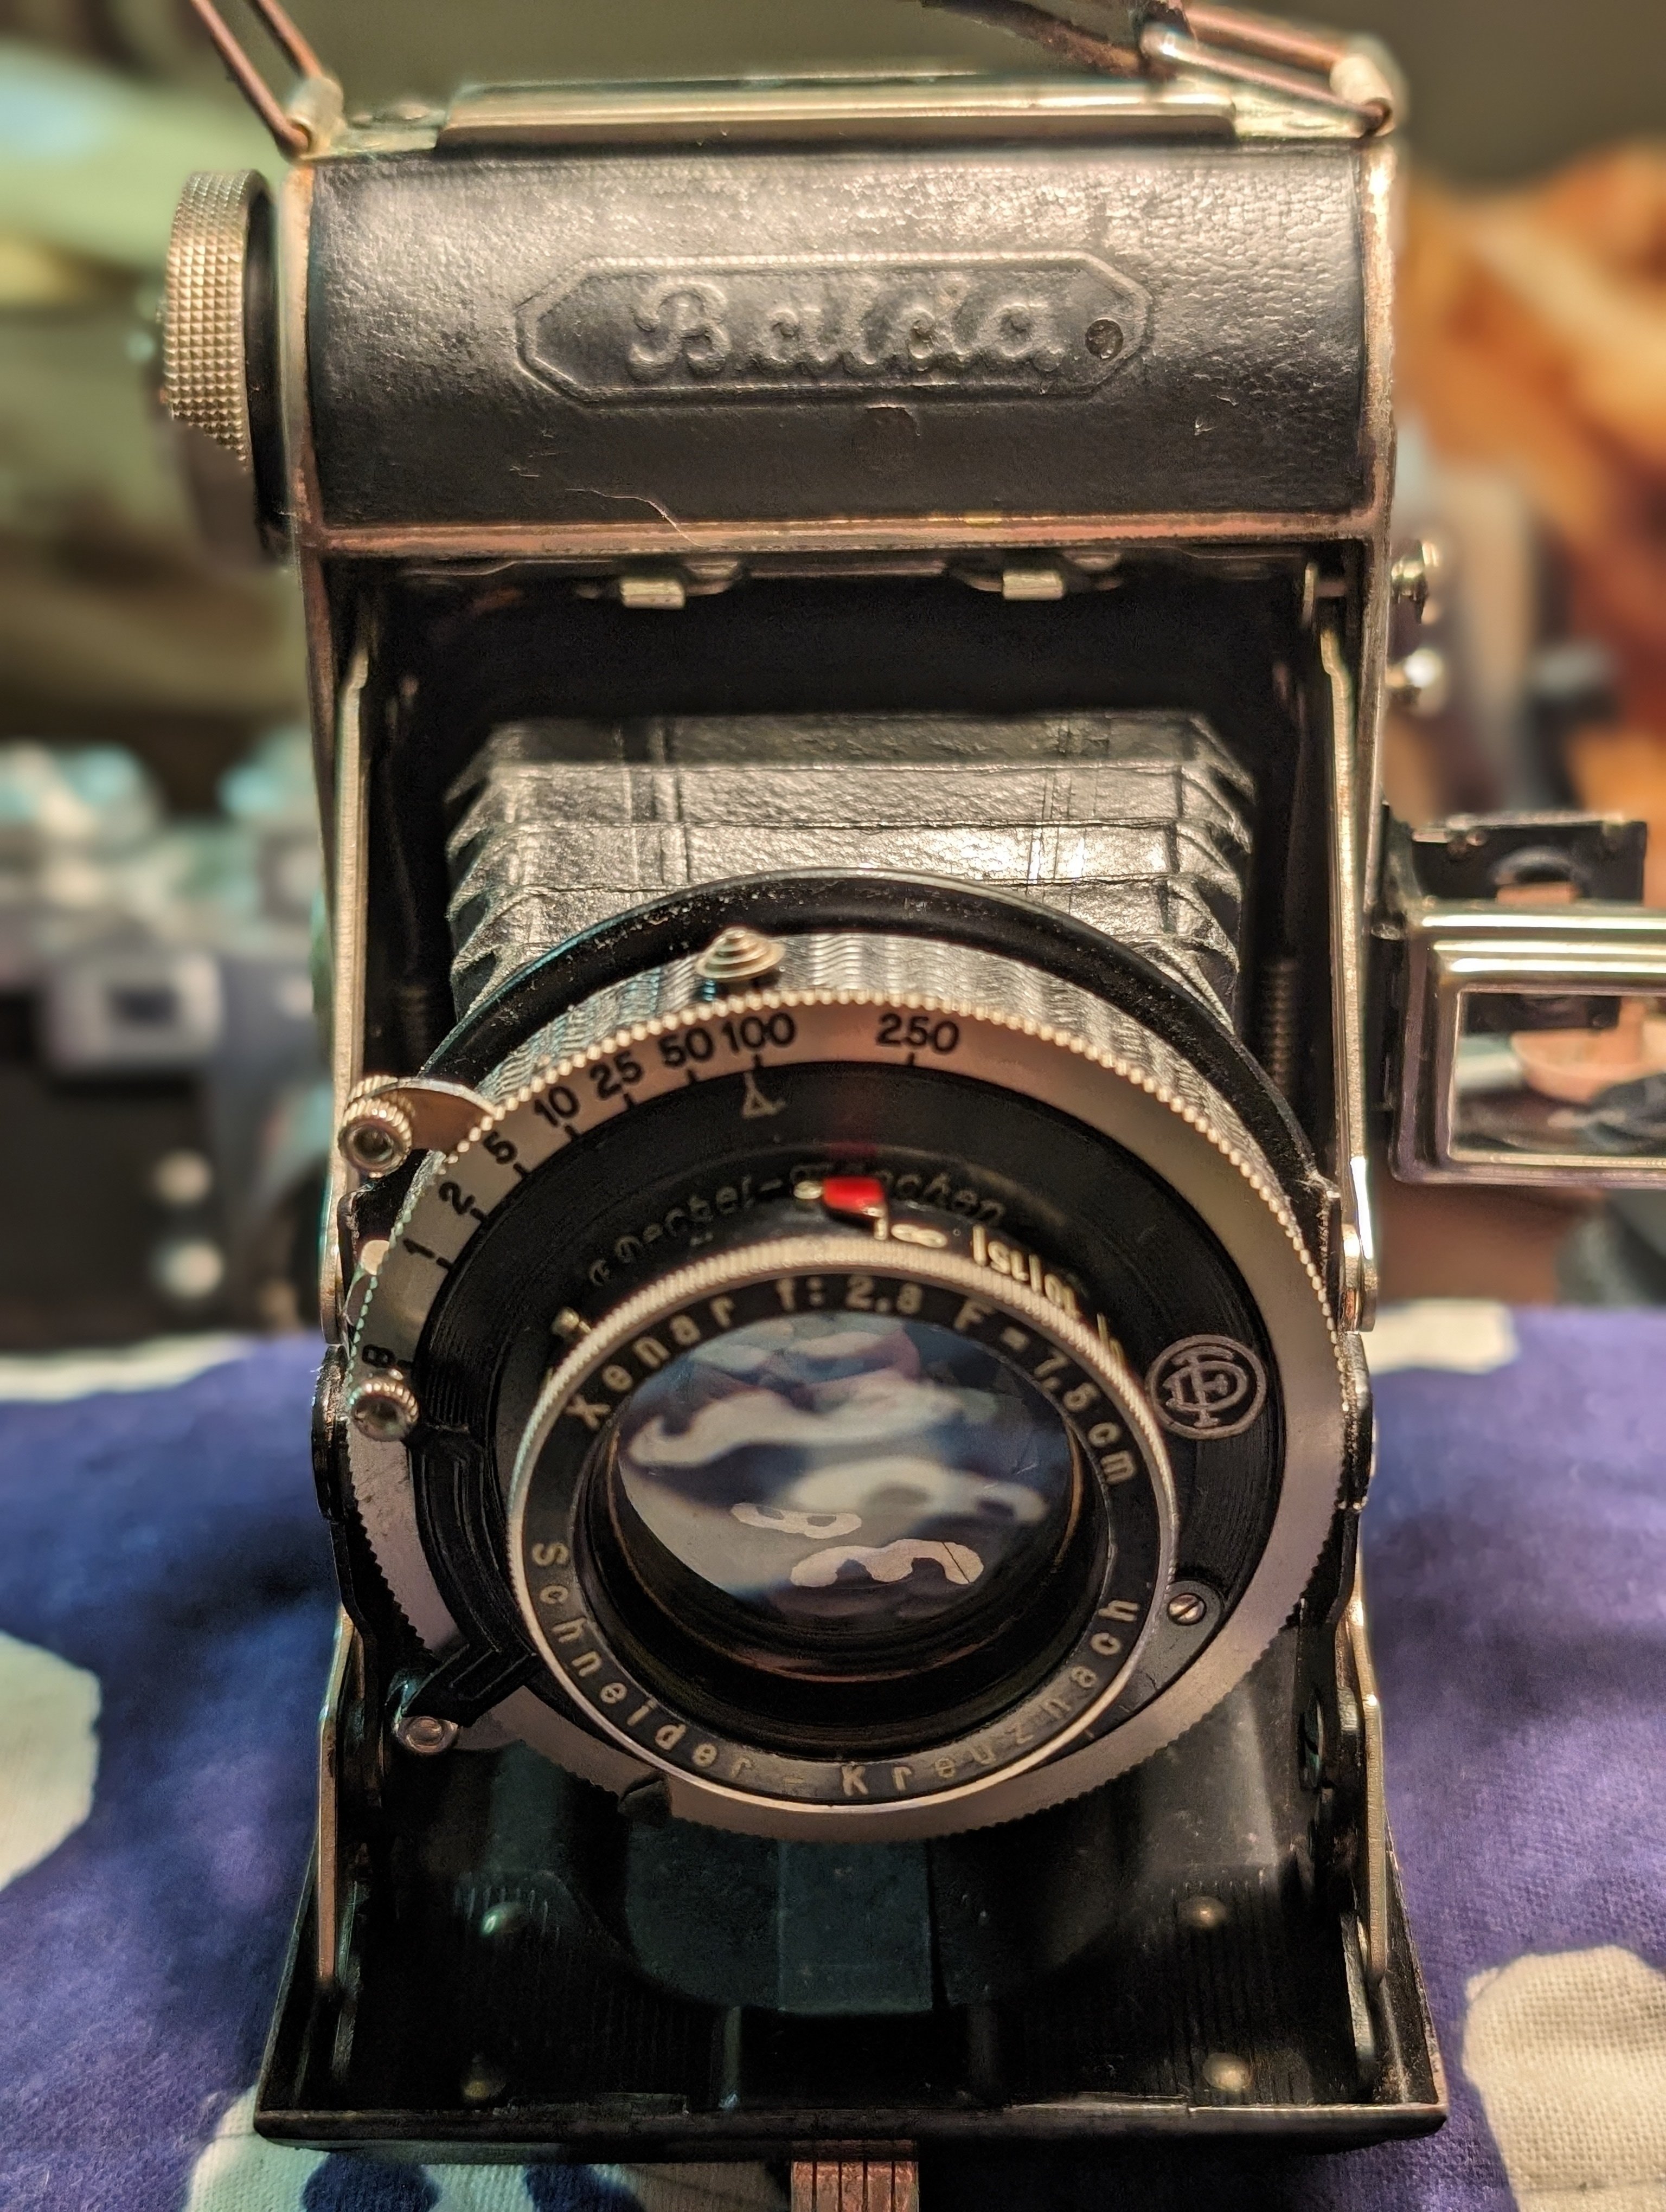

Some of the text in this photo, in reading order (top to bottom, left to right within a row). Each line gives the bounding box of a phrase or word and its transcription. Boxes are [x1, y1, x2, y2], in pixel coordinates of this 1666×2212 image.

[625, 275, 1073, 380] Balda
[402, 1238, 434, 1260] 1
[440, 1181, 475, 1216] 2
[483, 1133, 517, 1165] 5
[534, 1086, 580, 1127] 10
[589, 1051, 643, 1101] 25
[658, 1027, 715, 1069] 50
[721, 1012, 797, 1054] 100
[876, 1012, 960, 1055] 250
[565, 1296, 735, 1430] Xenar
